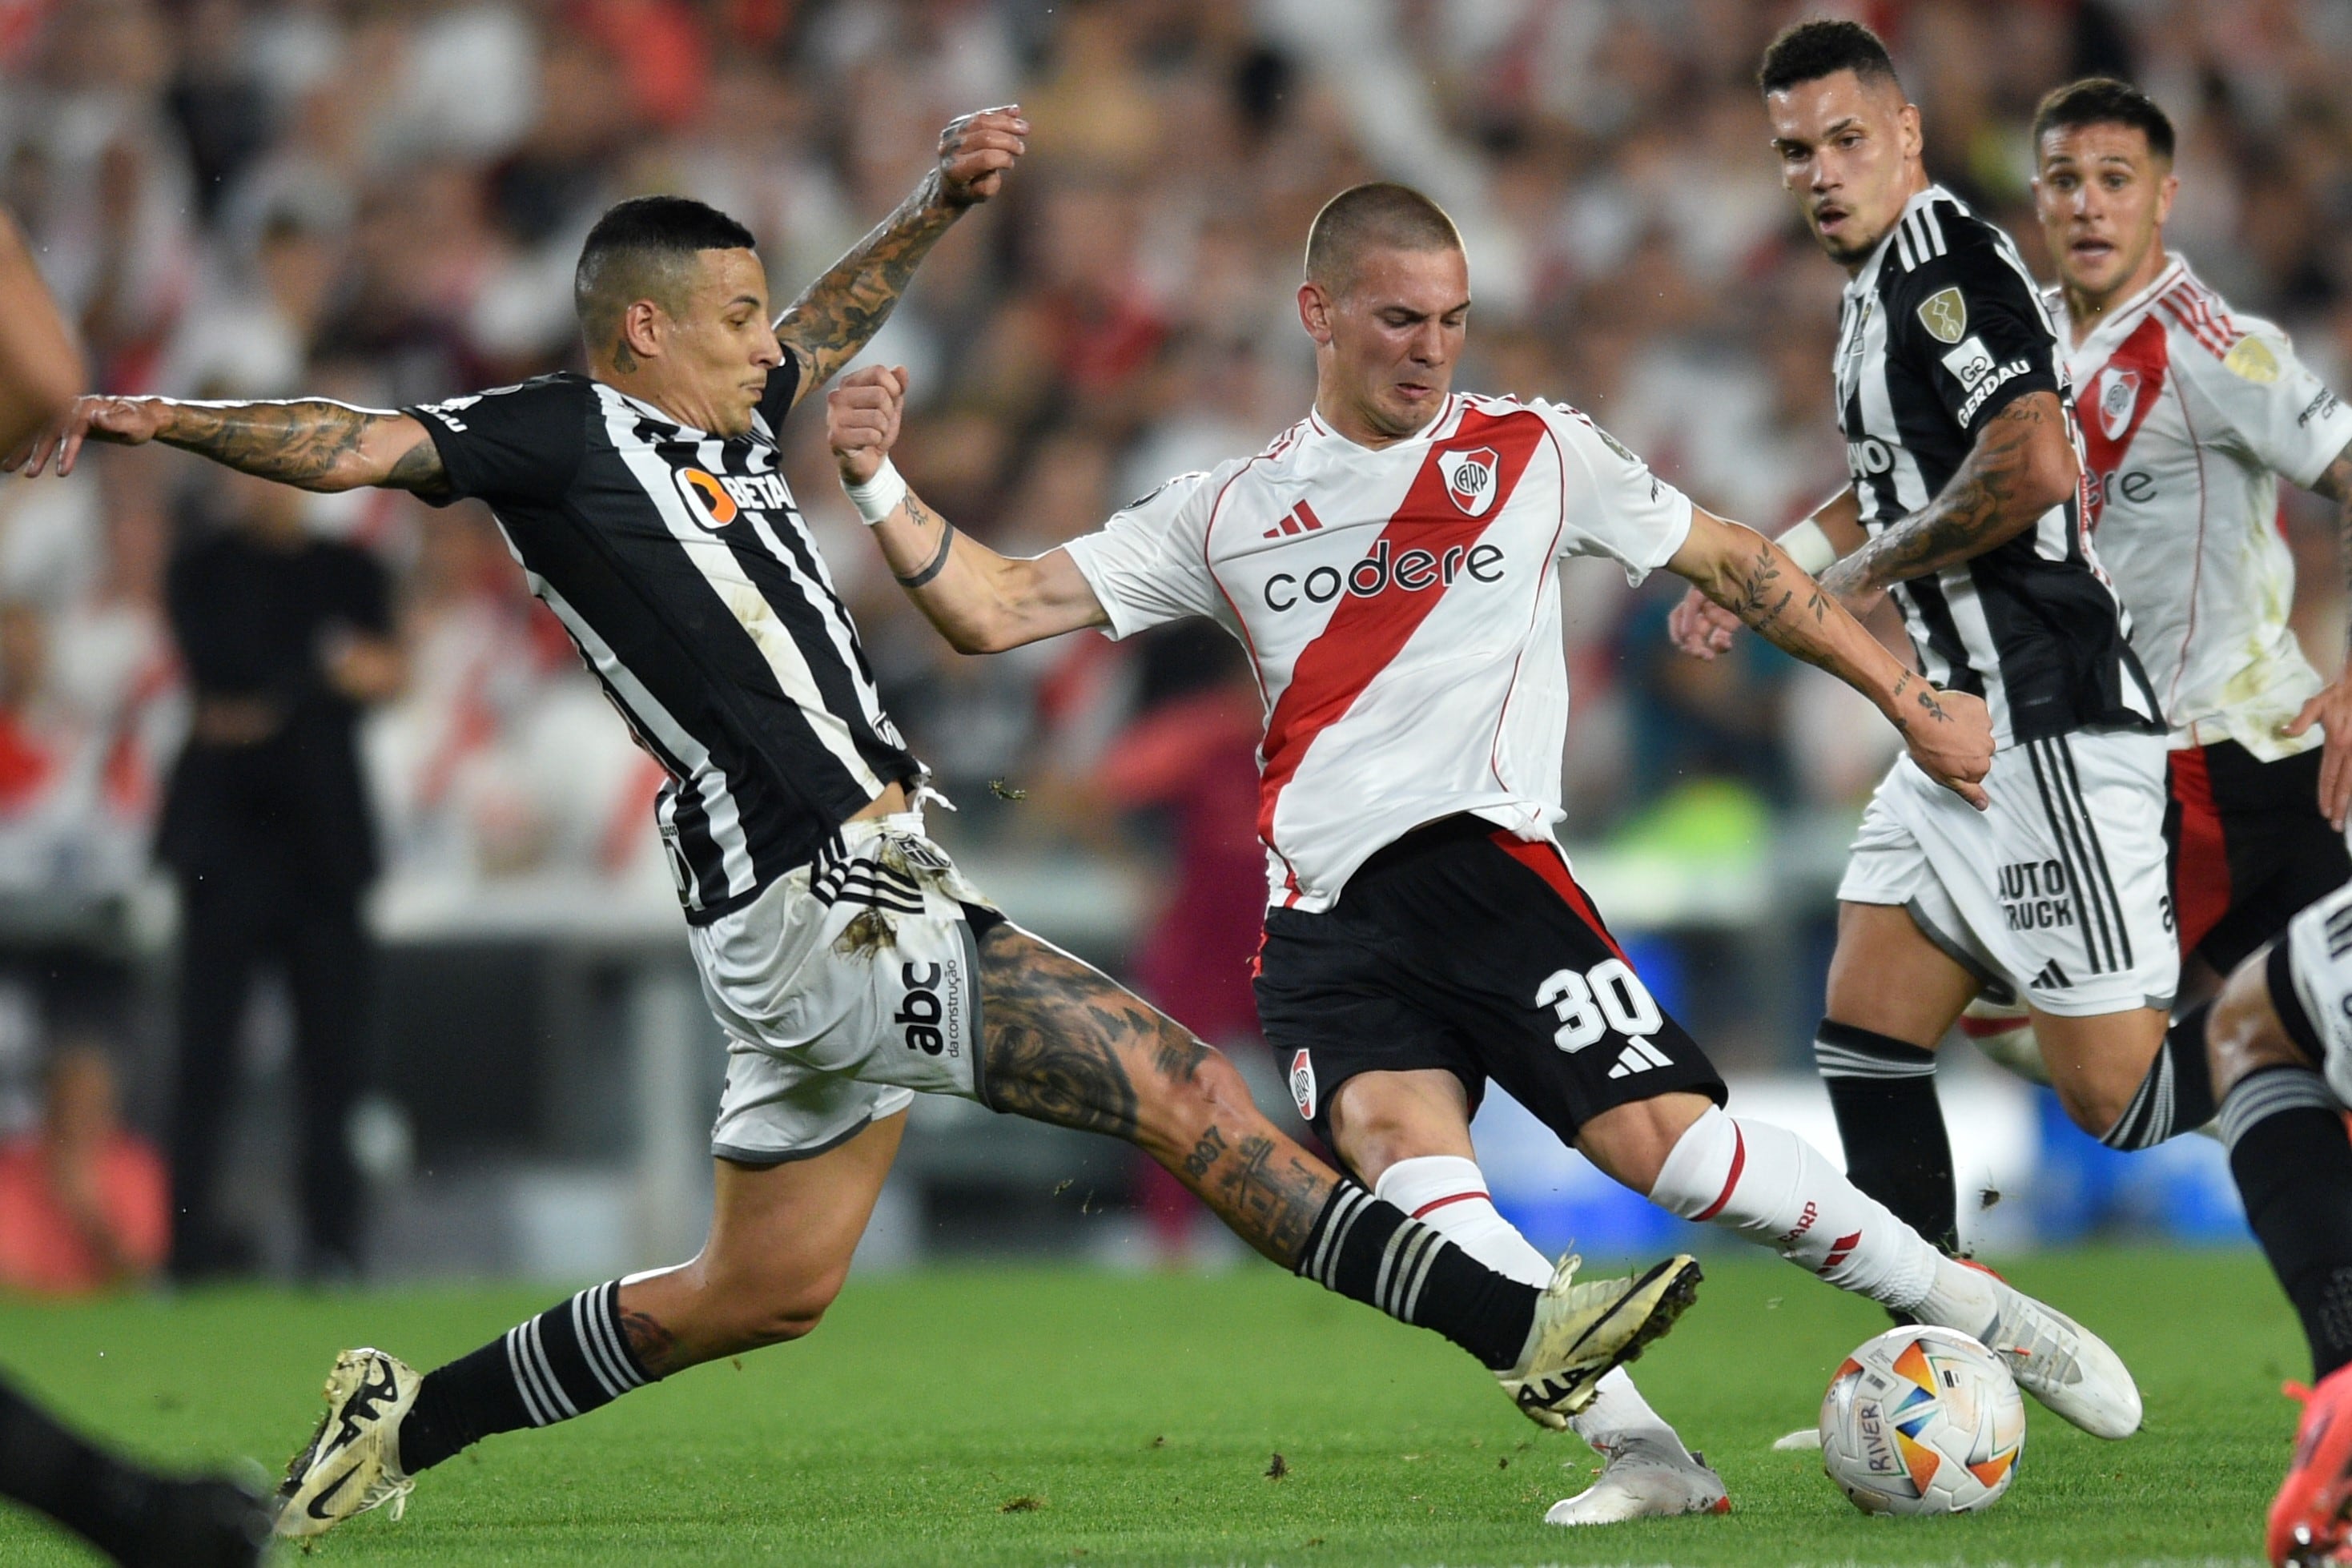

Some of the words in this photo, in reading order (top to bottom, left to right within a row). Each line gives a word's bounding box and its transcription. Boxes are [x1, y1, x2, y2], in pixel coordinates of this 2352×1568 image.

[1957, 360, 2032, 430] GERDAU
[719, 473, 798, 510] BETA
[1454, 463, 1488, 494] CARP
[1263, 540, 1506, 613] codere
[2003, 898, 2074, 931] RUCK
[894, 962, 944, 1056] abc
[944, 959, 962, 1039] construção
[1535, 958, 1664, 1054] 30
[947, 1040, 960, 1058] da
[1860, 1404, 1892, 1472] RIVER
